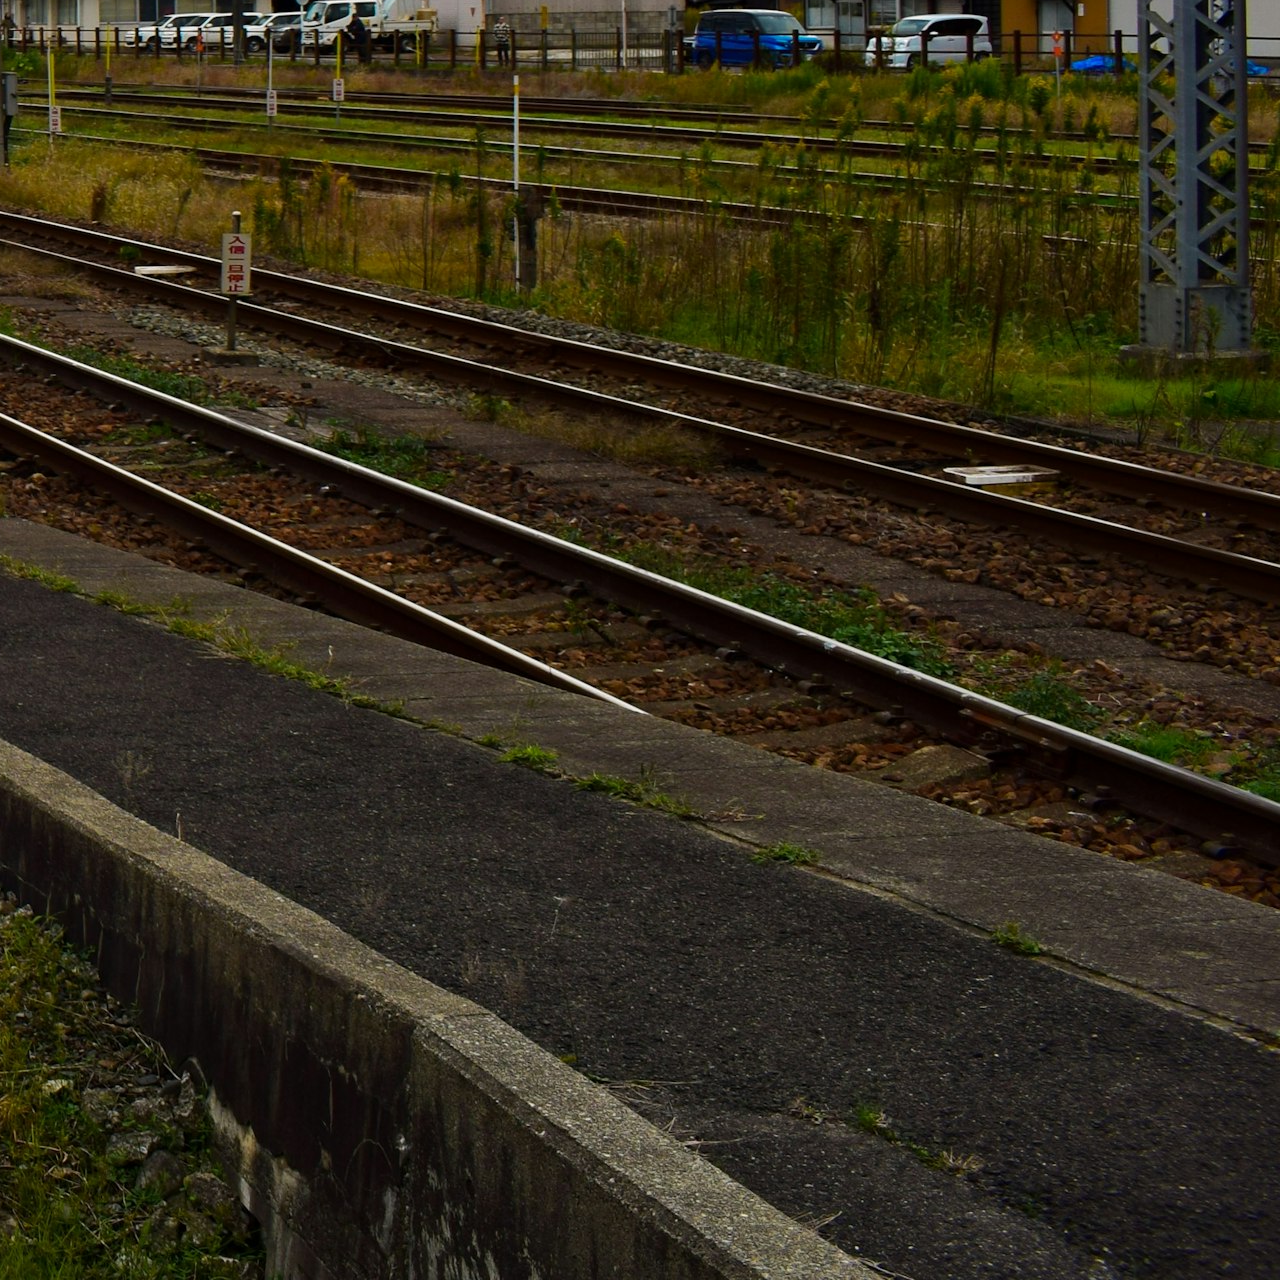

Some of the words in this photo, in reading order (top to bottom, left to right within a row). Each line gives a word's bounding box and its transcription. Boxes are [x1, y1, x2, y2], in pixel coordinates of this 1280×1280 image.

[226, 236, 246, 293] 入信一旦停止
